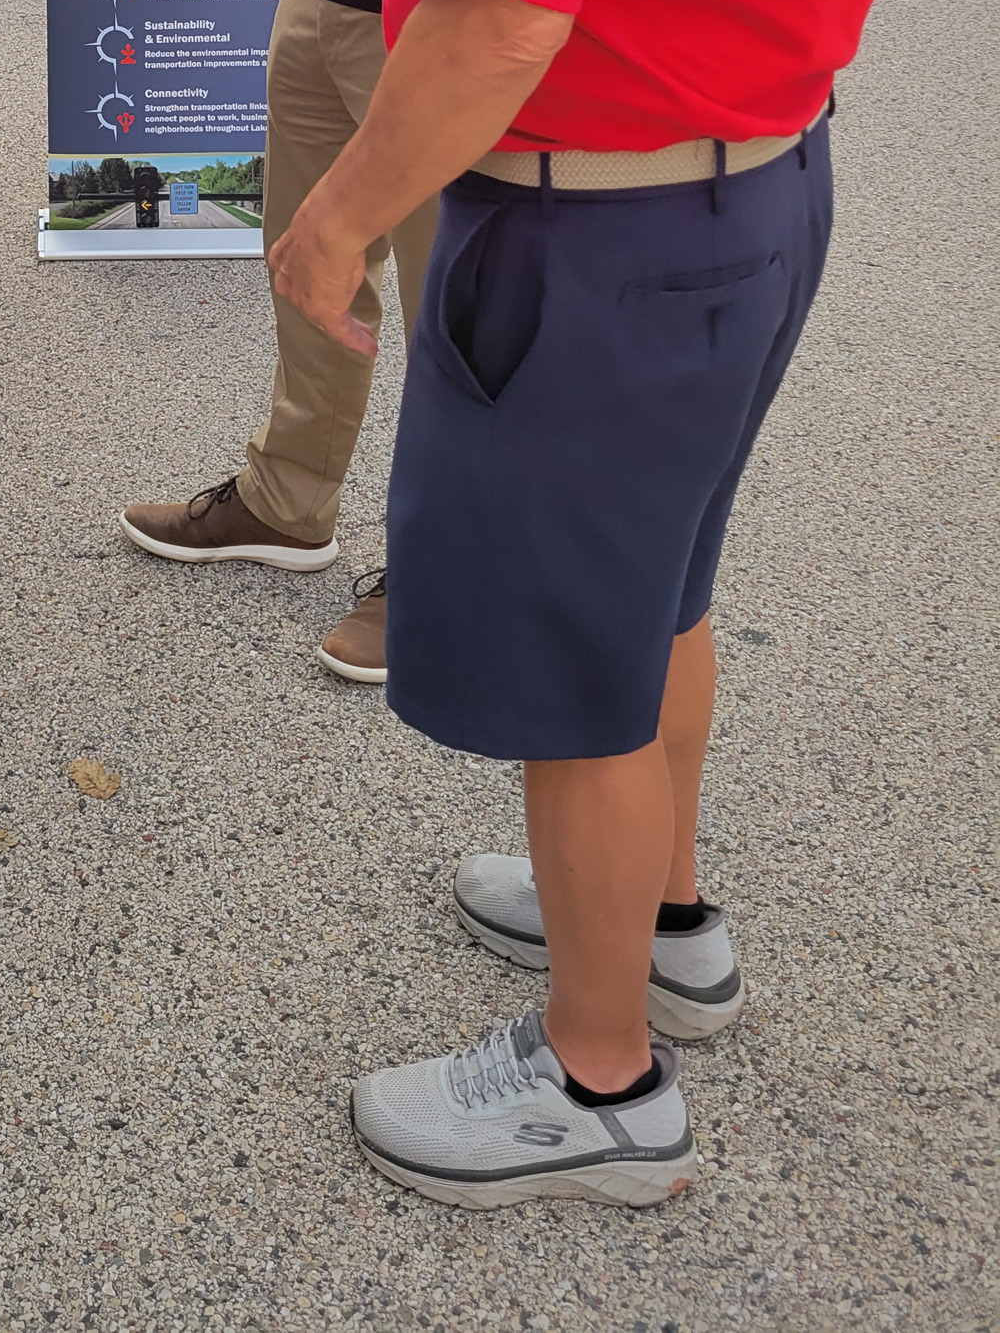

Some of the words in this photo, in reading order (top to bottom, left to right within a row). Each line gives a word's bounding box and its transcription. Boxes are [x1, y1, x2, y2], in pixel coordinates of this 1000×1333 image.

[144, 19, 216, 31] Sustainability
[145, 34, 154, 44] &
[156, 32, 231, 44] Environmental
[144, 50, 175, 58] Reduce
[176, 49, 190, 57] the
[191, 48, 249, 57] environmental
[250, 47, 269, 57] impa
[144, 60, 202, 70] transportation
[203, 59, 260, 68] improvements
[144, 88, 209, 99] Connectivity
[144, 104, 189, 113] Strengthen
[190, 102, 248, 112] transportation
[249, 102, 268, 111] links
[144, 115, 178, 123] connect
[178, 114, 206, 123] people
[207, 114, 216, 122] to
[217, 113, 240, 122] work,
[241, 112, 268, 121] busine
[144, 125, 204, 135] neighborhoods
[205, 124, 250, 134] throughout
